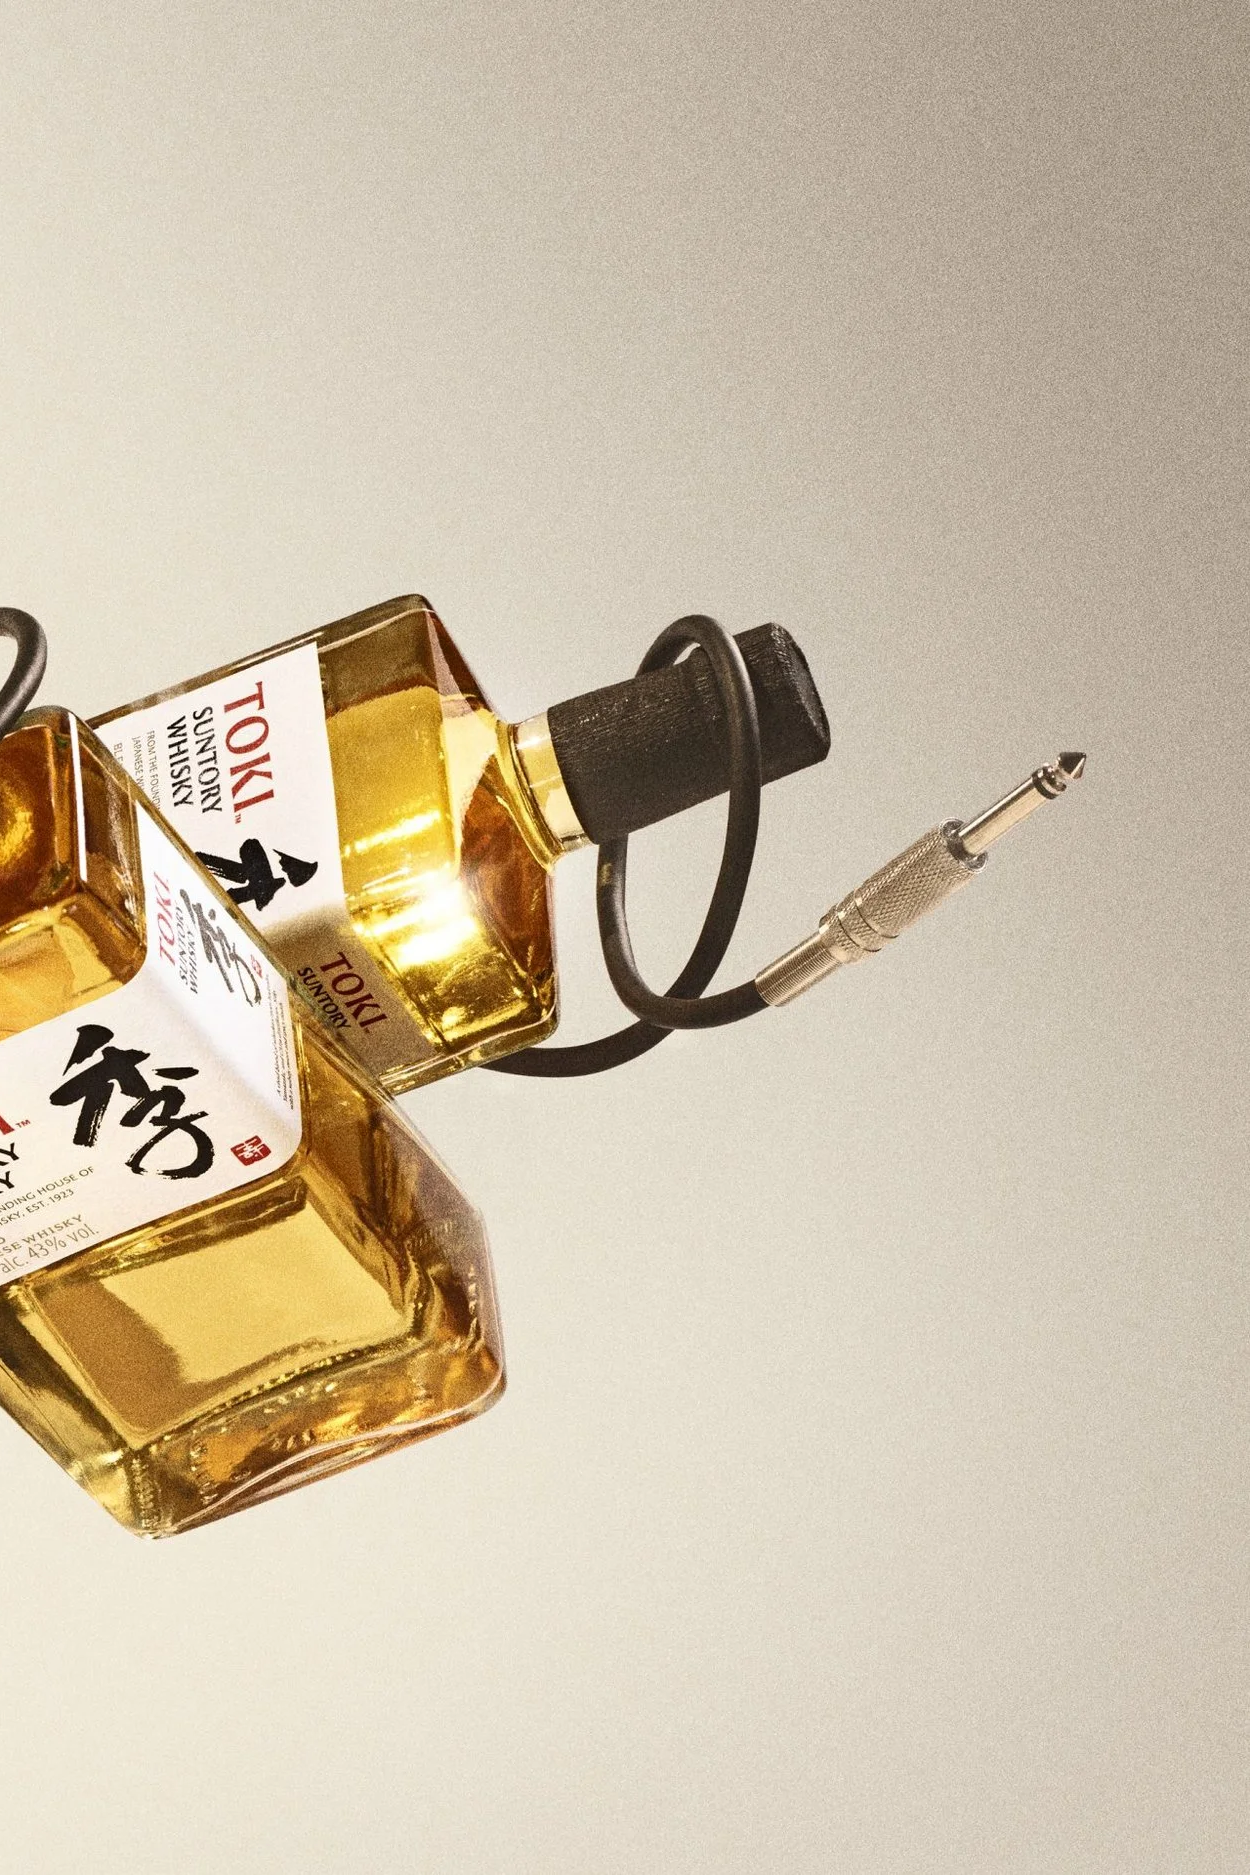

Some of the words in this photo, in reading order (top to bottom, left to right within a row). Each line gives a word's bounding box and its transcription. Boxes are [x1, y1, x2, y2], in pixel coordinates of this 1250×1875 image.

[131, 735, 144, 776] JAPANESE
[147, 730, 156, 755] FROM
[166, 715, 194, 807] WHISKY
[192, 706, 223, 814] SUNTORY
[223, 681, 275, 813] TOKI
[149, 755, 157, 773] THE
[150, 773, 161, 810] FOUND
[153, 871, 176, 966] TOKI
[297, 967, 352, 1029] SUNTORY
[320, 951, 388, 1027] TOKI
[50, 1024, 214, 1181] 季
[26, 1202, 49, 1214] EST.
[49, 1188, 75, 1204] 1923
[37, 1174, 76, 1195] HOUSE
[79, 1166, 95, 1178] OF
[21, 1214, 84, 1245] WHISKY
[28, 1236, 67, 1260] 43%
[66, 1223, 100, 1244] vol.
